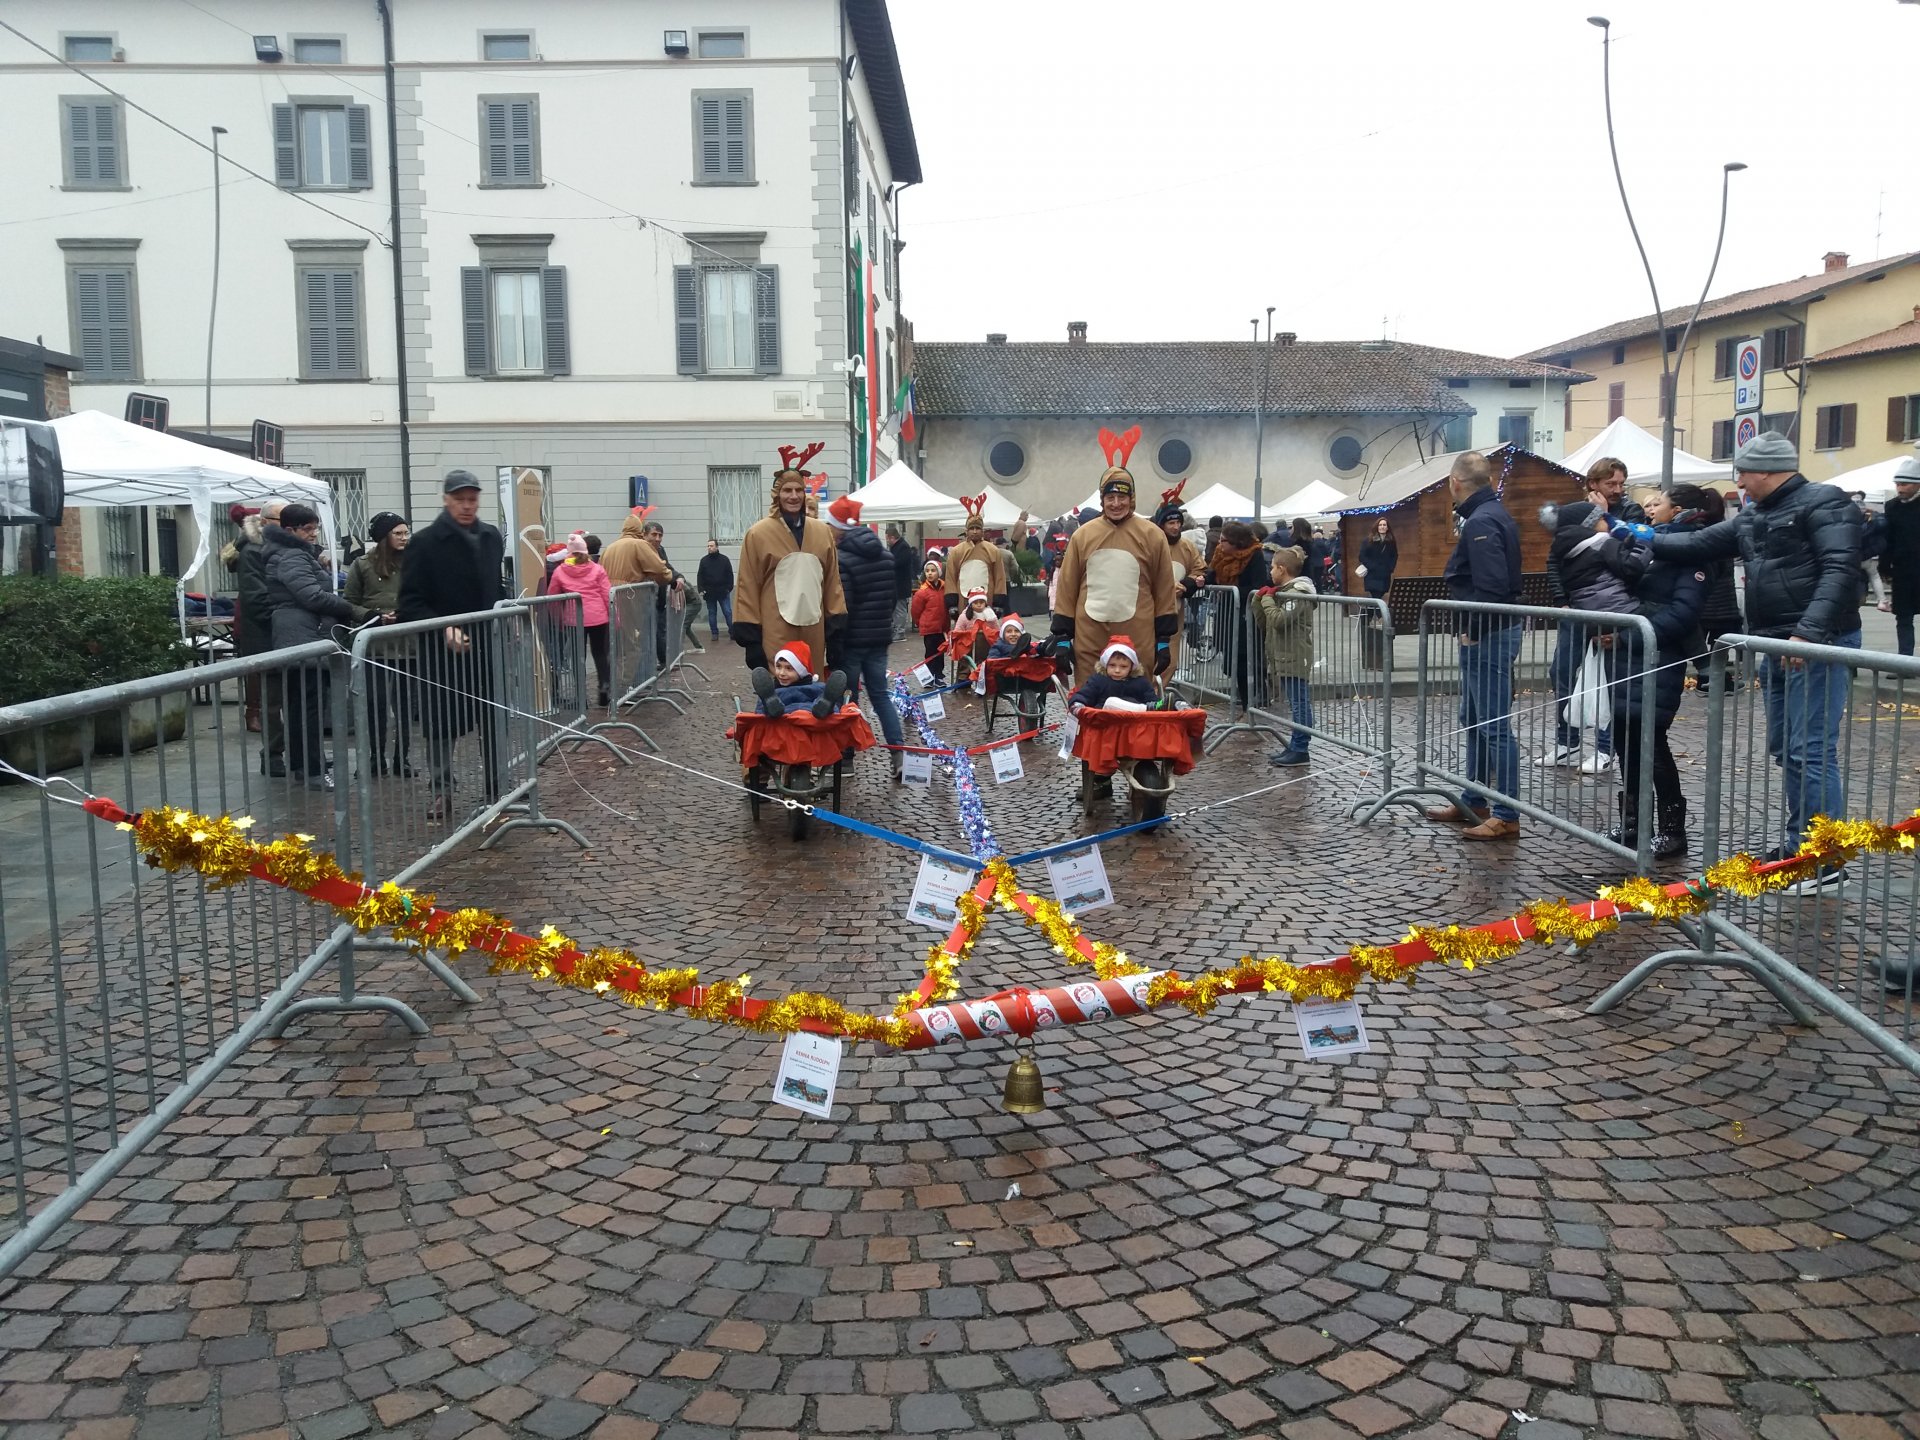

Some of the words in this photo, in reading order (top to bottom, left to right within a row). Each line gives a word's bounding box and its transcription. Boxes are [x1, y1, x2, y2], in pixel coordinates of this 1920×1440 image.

[1072, 862, 1078, 870] 3
[942, 873, 949, 882] 2
[812, 1041, 817, 1050] 1
